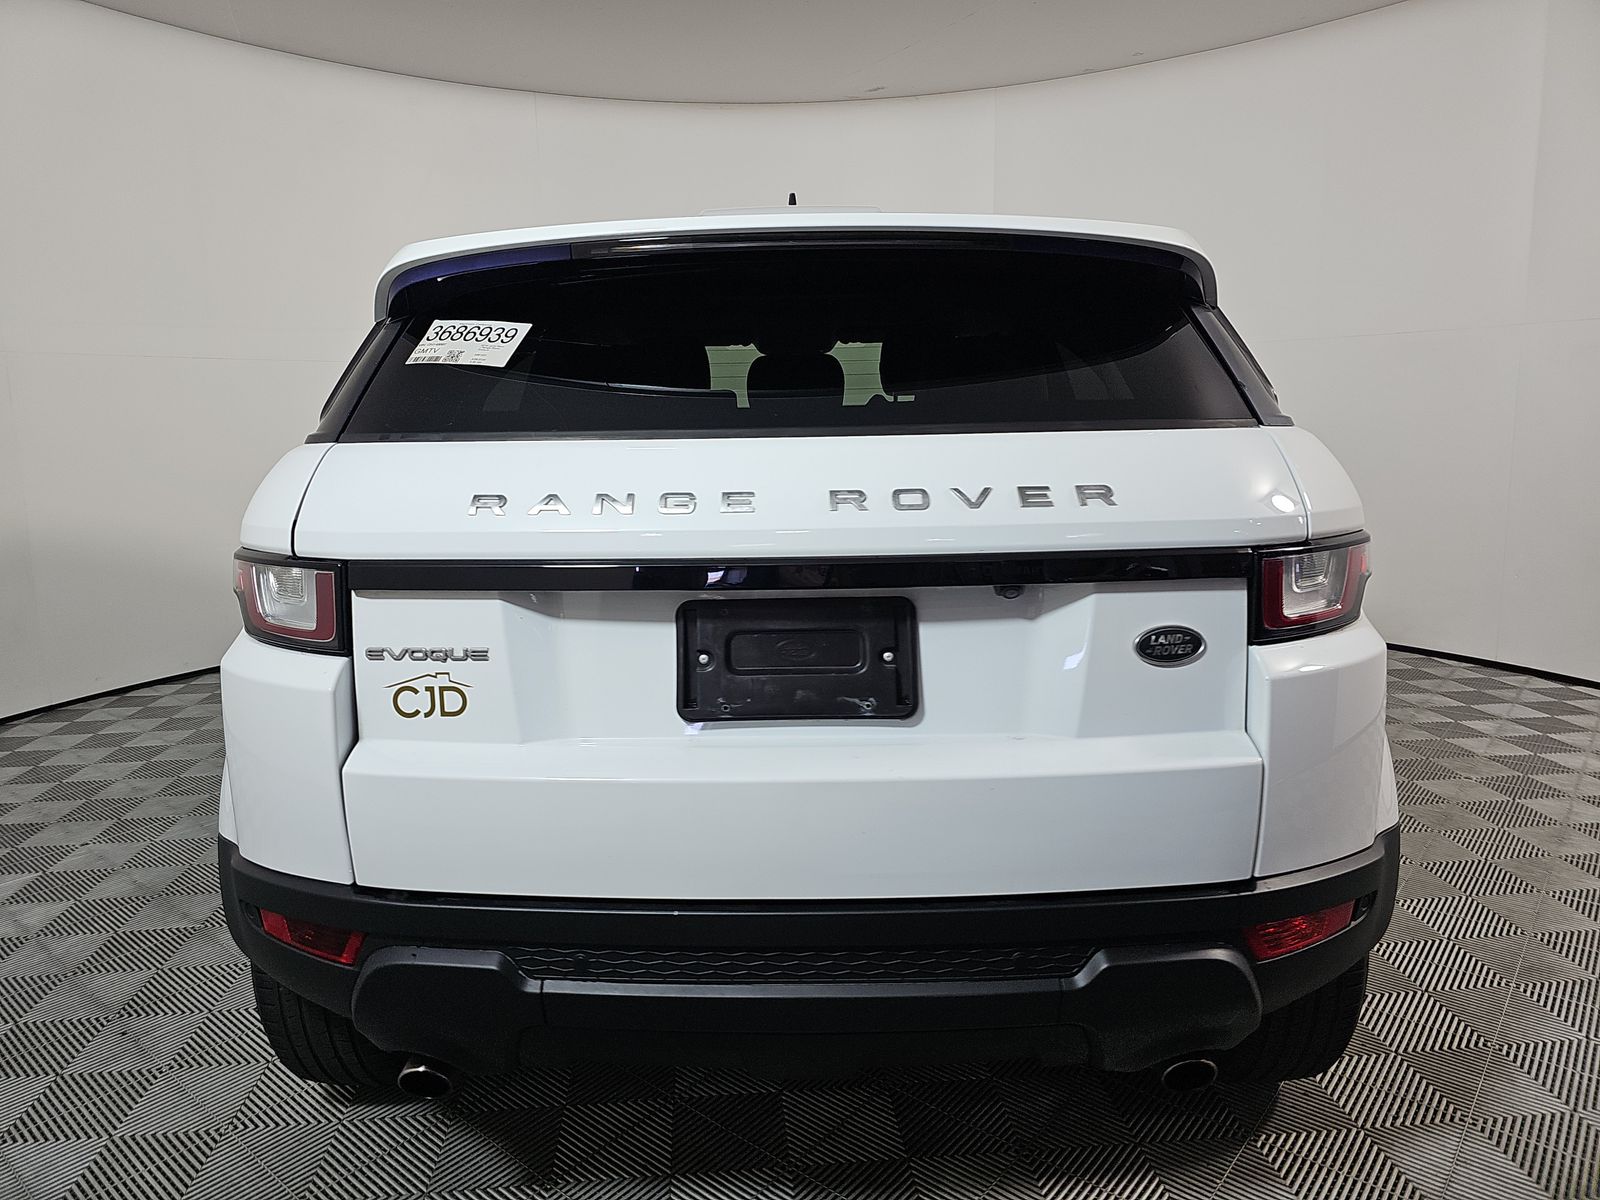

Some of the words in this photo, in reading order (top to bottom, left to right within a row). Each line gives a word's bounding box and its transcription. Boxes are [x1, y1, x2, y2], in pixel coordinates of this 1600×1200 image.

[426, 325, 519, 344] 3686939
[467, 491, 757, 517] RANGE
[828, 484, 1119, 512] ROVER
[365, 646, 490, 663] EVOQUE
[392, 685, 468, 719] CJD
